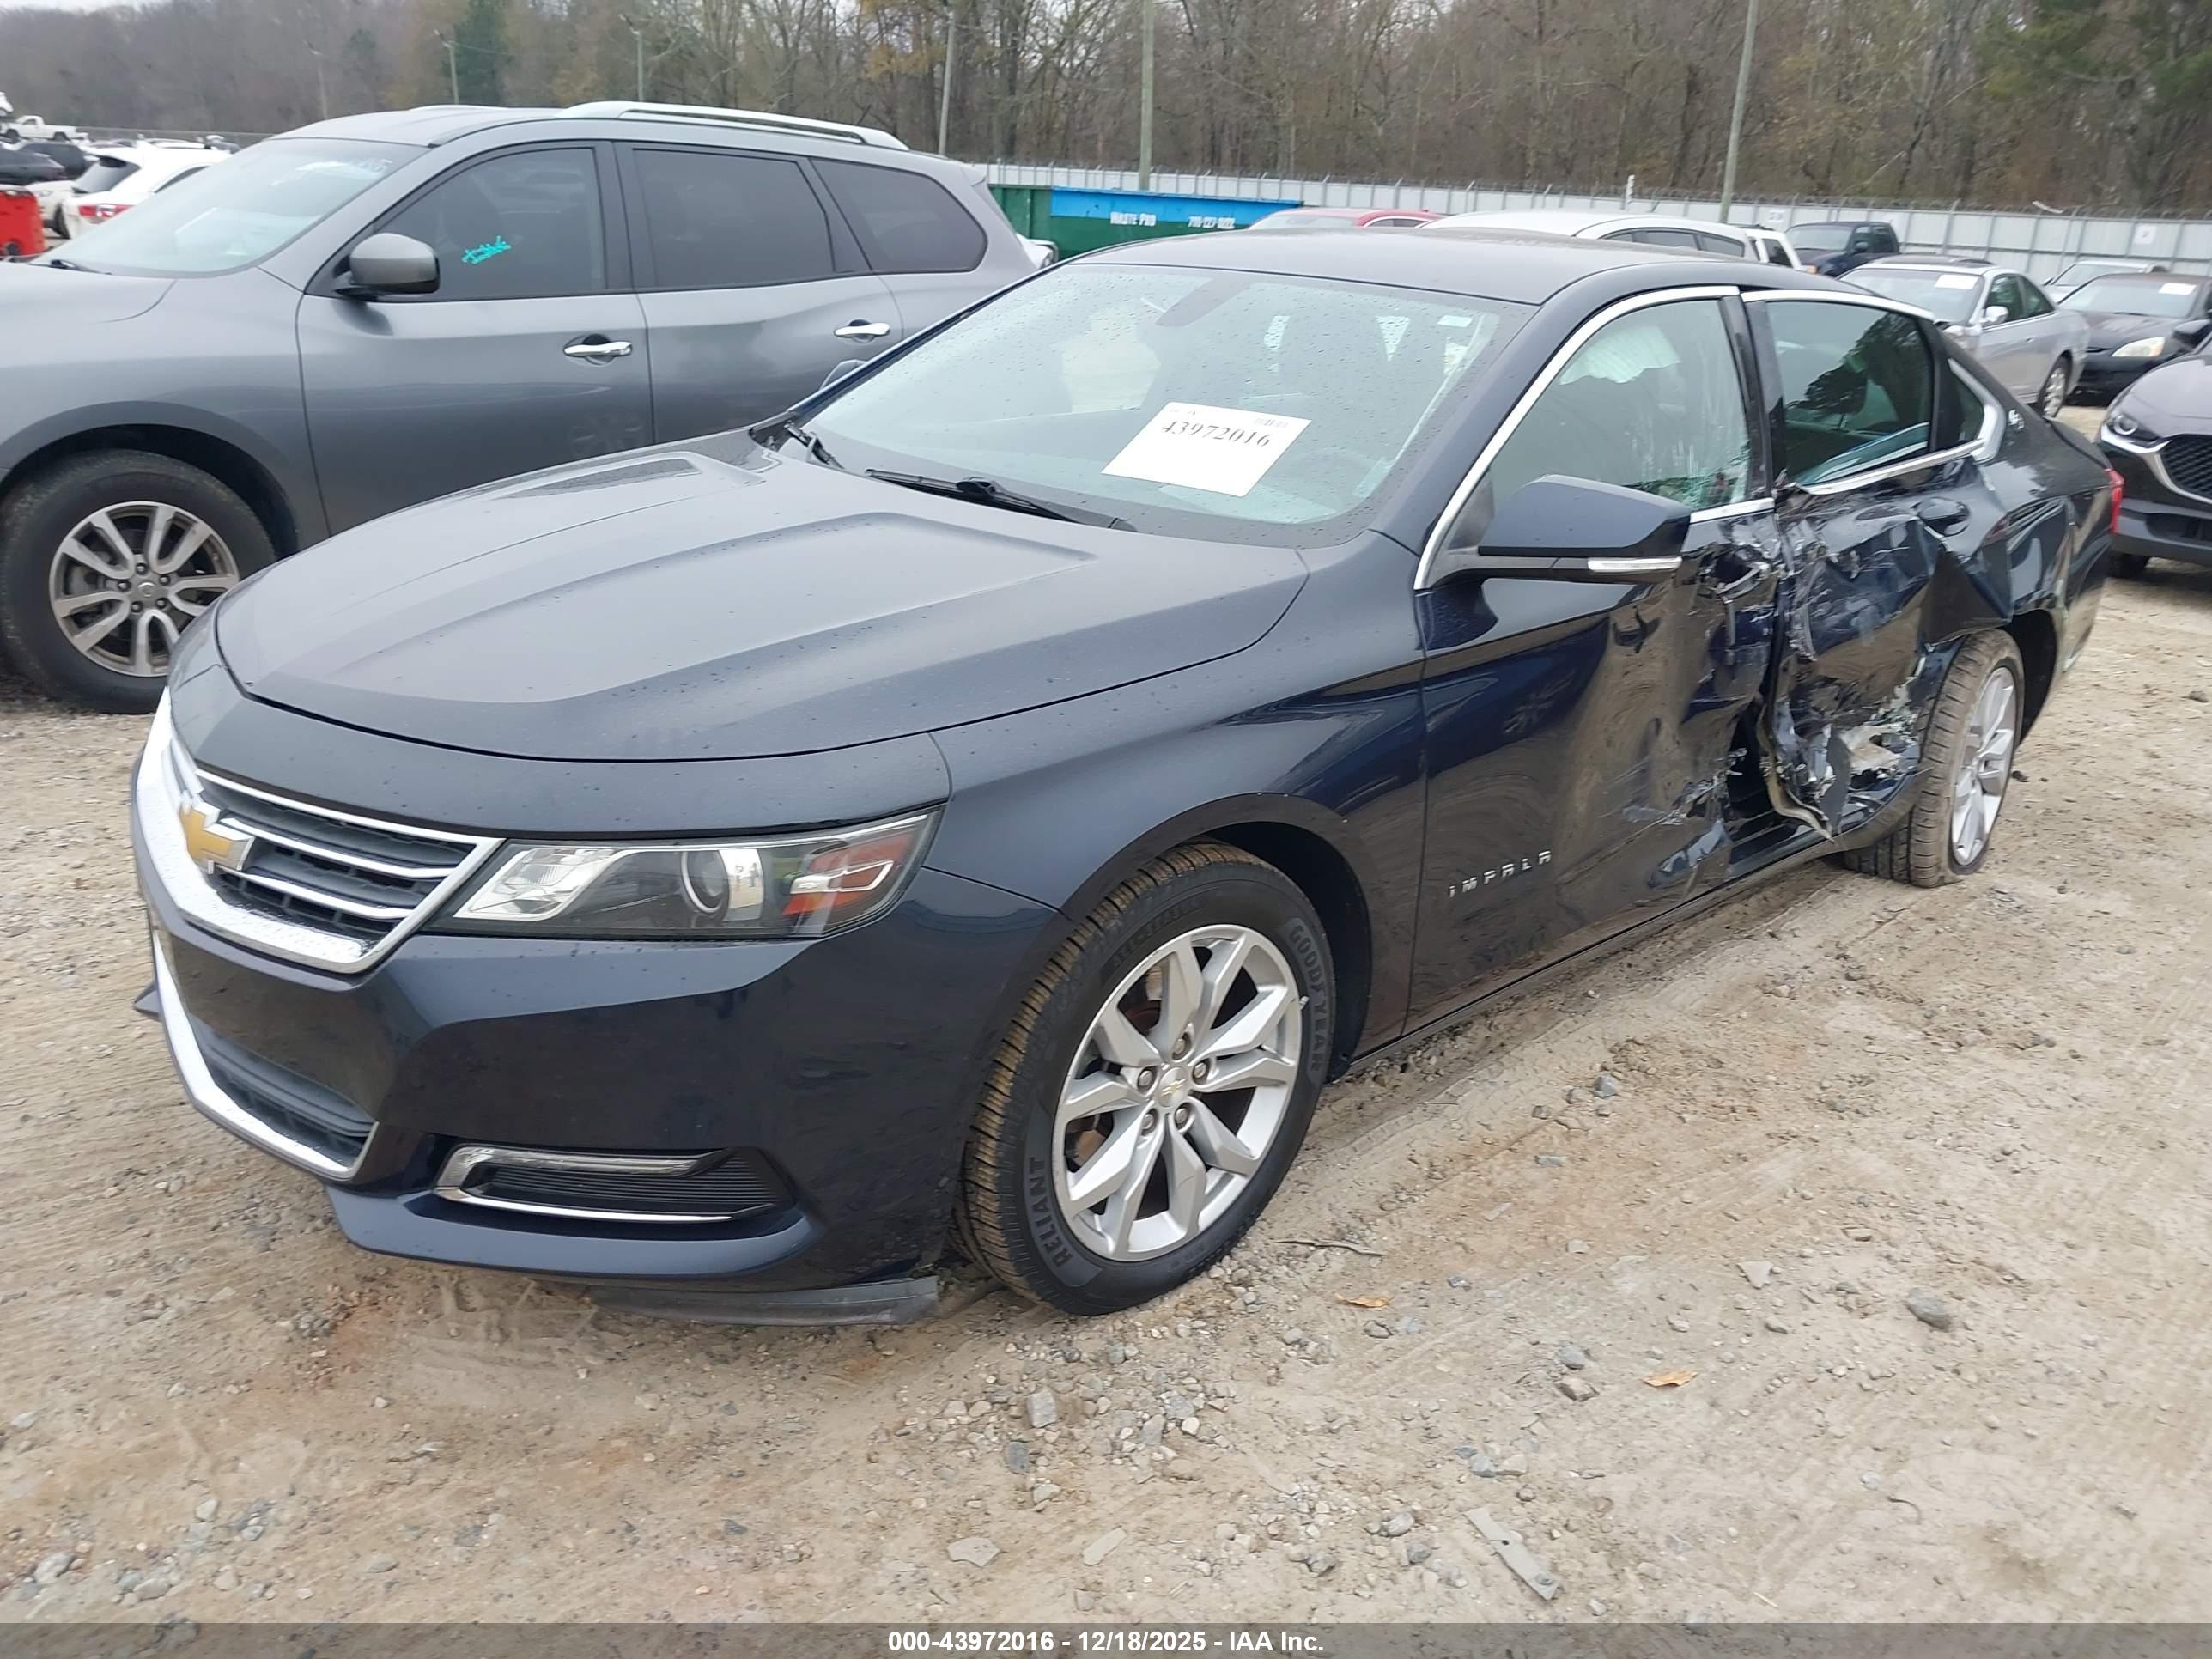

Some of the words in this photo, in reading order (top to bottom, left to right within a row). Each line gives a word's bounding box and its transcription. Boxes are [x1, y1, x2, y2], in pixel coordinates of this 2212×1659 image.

[1161, 421, 1272, 447] 43972016
[1449, 850, 1552, 899] IMPALA
[1288, 923, 1328, 1073] GOODYEAR
[1029, 1156, 1074, 1267] RELIANT
